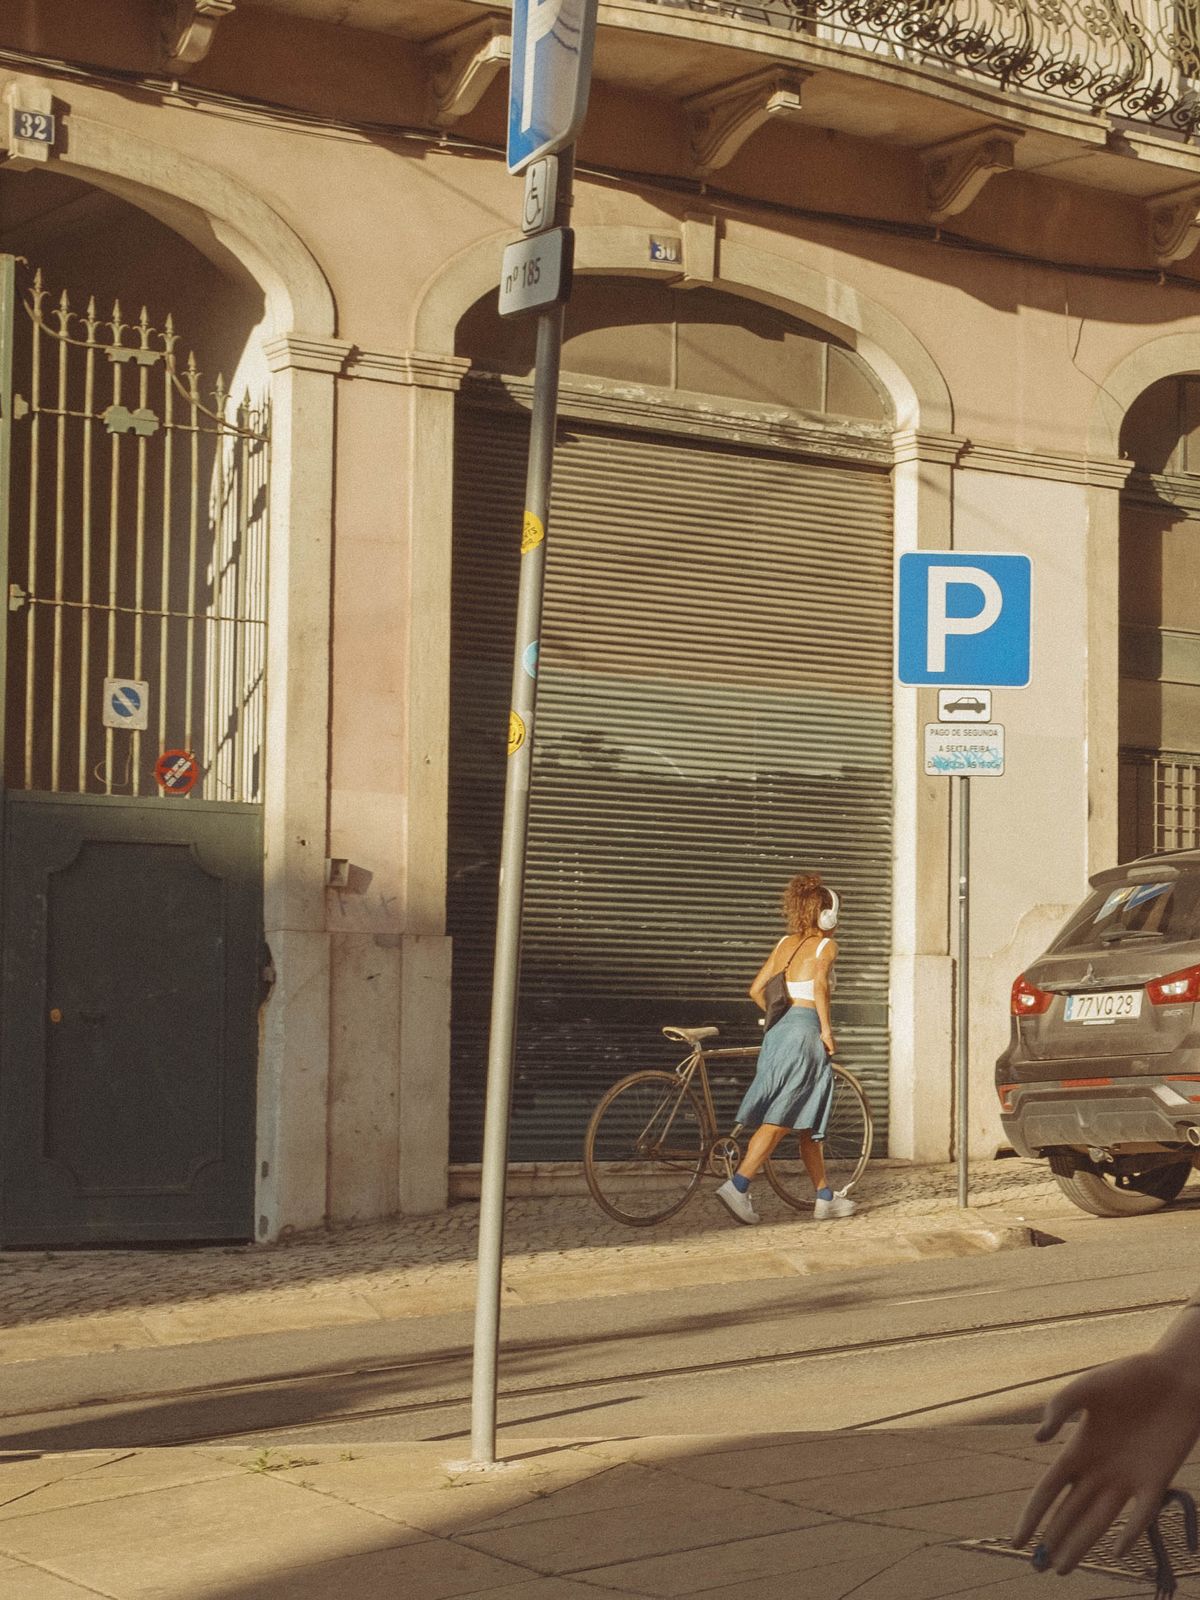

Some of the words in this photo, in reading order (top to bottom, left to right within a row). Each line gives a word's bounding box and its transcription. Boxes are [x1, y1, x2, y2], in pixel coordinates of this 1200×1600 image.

[21, 113, 47, 139] 32
[522, 257, 541, 289] 185
[926, 565, 1003, 673] P
[930, 728, 950, 737] PAGO
[952, 728, 961, 737] DE
[963, 728, 998, 737] SEGUNDA
